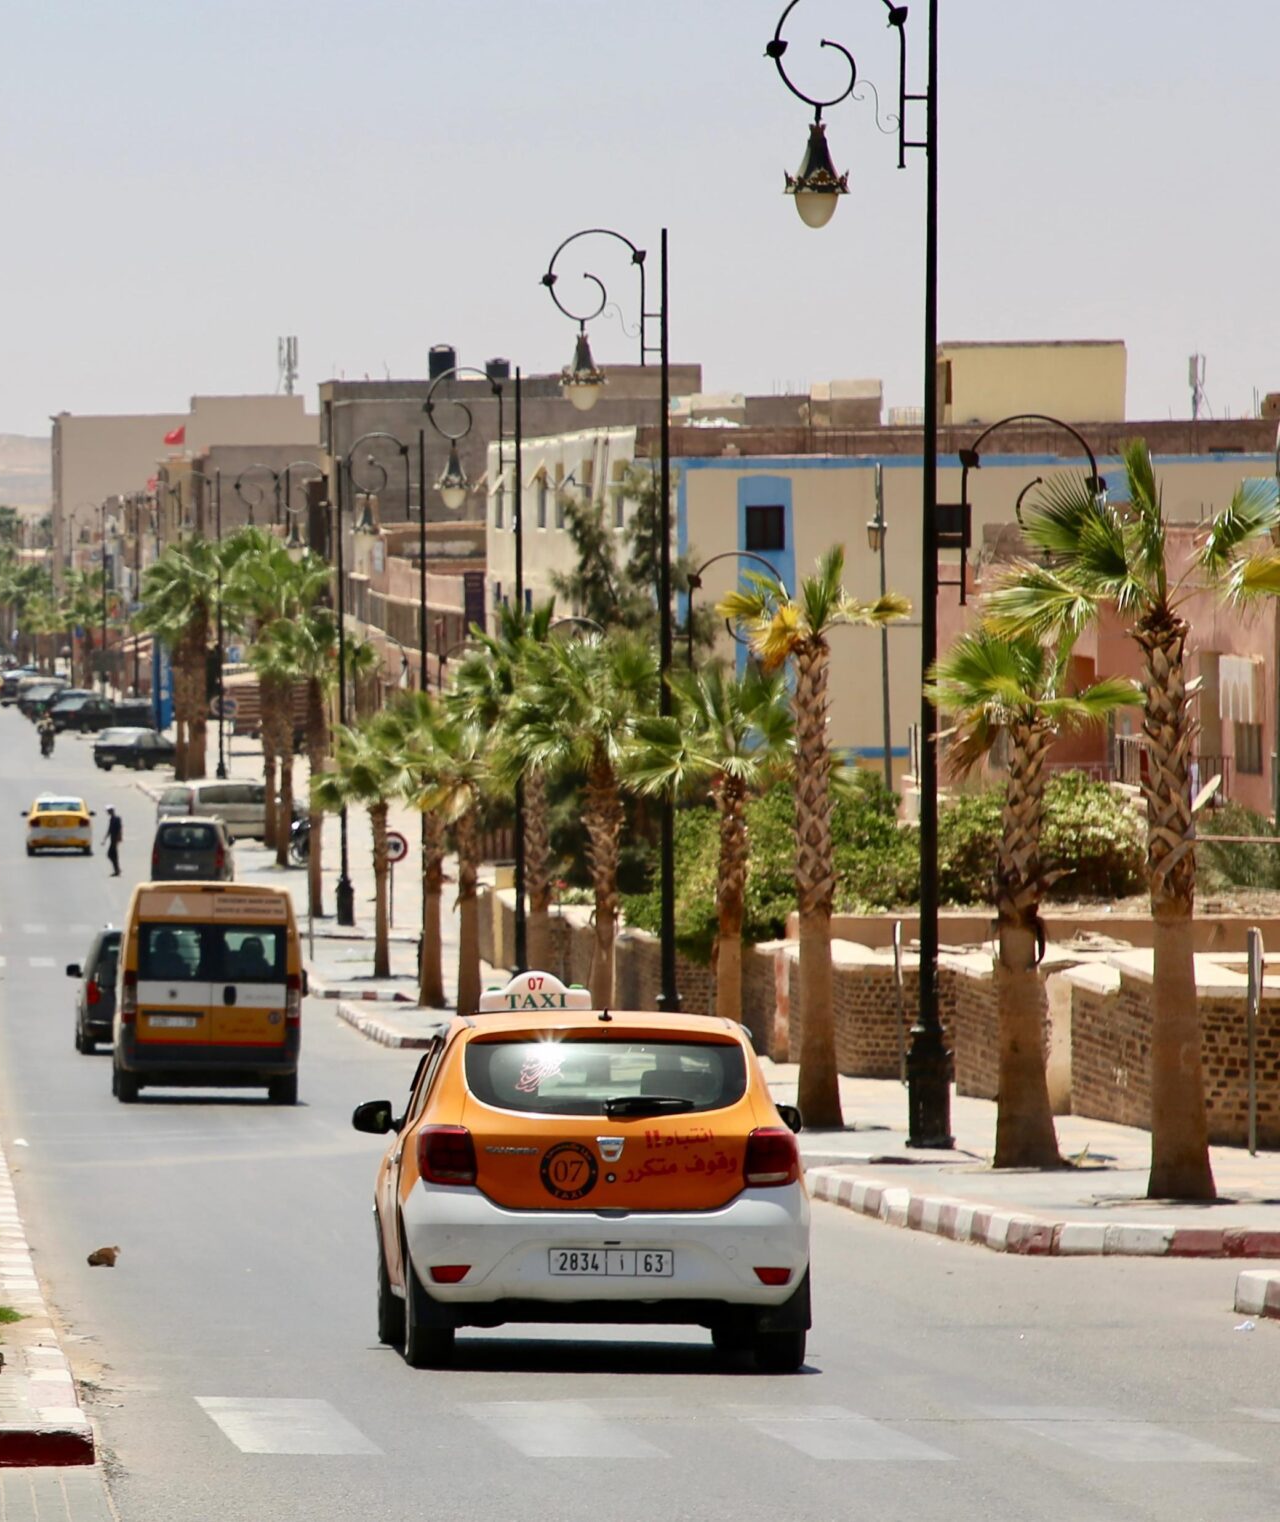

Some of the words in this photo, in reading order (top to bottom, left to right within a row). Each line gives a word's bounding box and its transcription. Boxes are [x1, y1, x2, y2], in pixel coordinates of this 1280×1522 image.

[527, 977, 544, 991] 07
[505, 993, 568, 1009] TAXI
[553, 1160, 585, 1183] 07
[623, 1157, 678, 1183] متكرر
[685, 1151, 738, 1176] وقوف
[558, 1252, 600, 1272] 2834
[643, 1253, 664, 1273] 63
